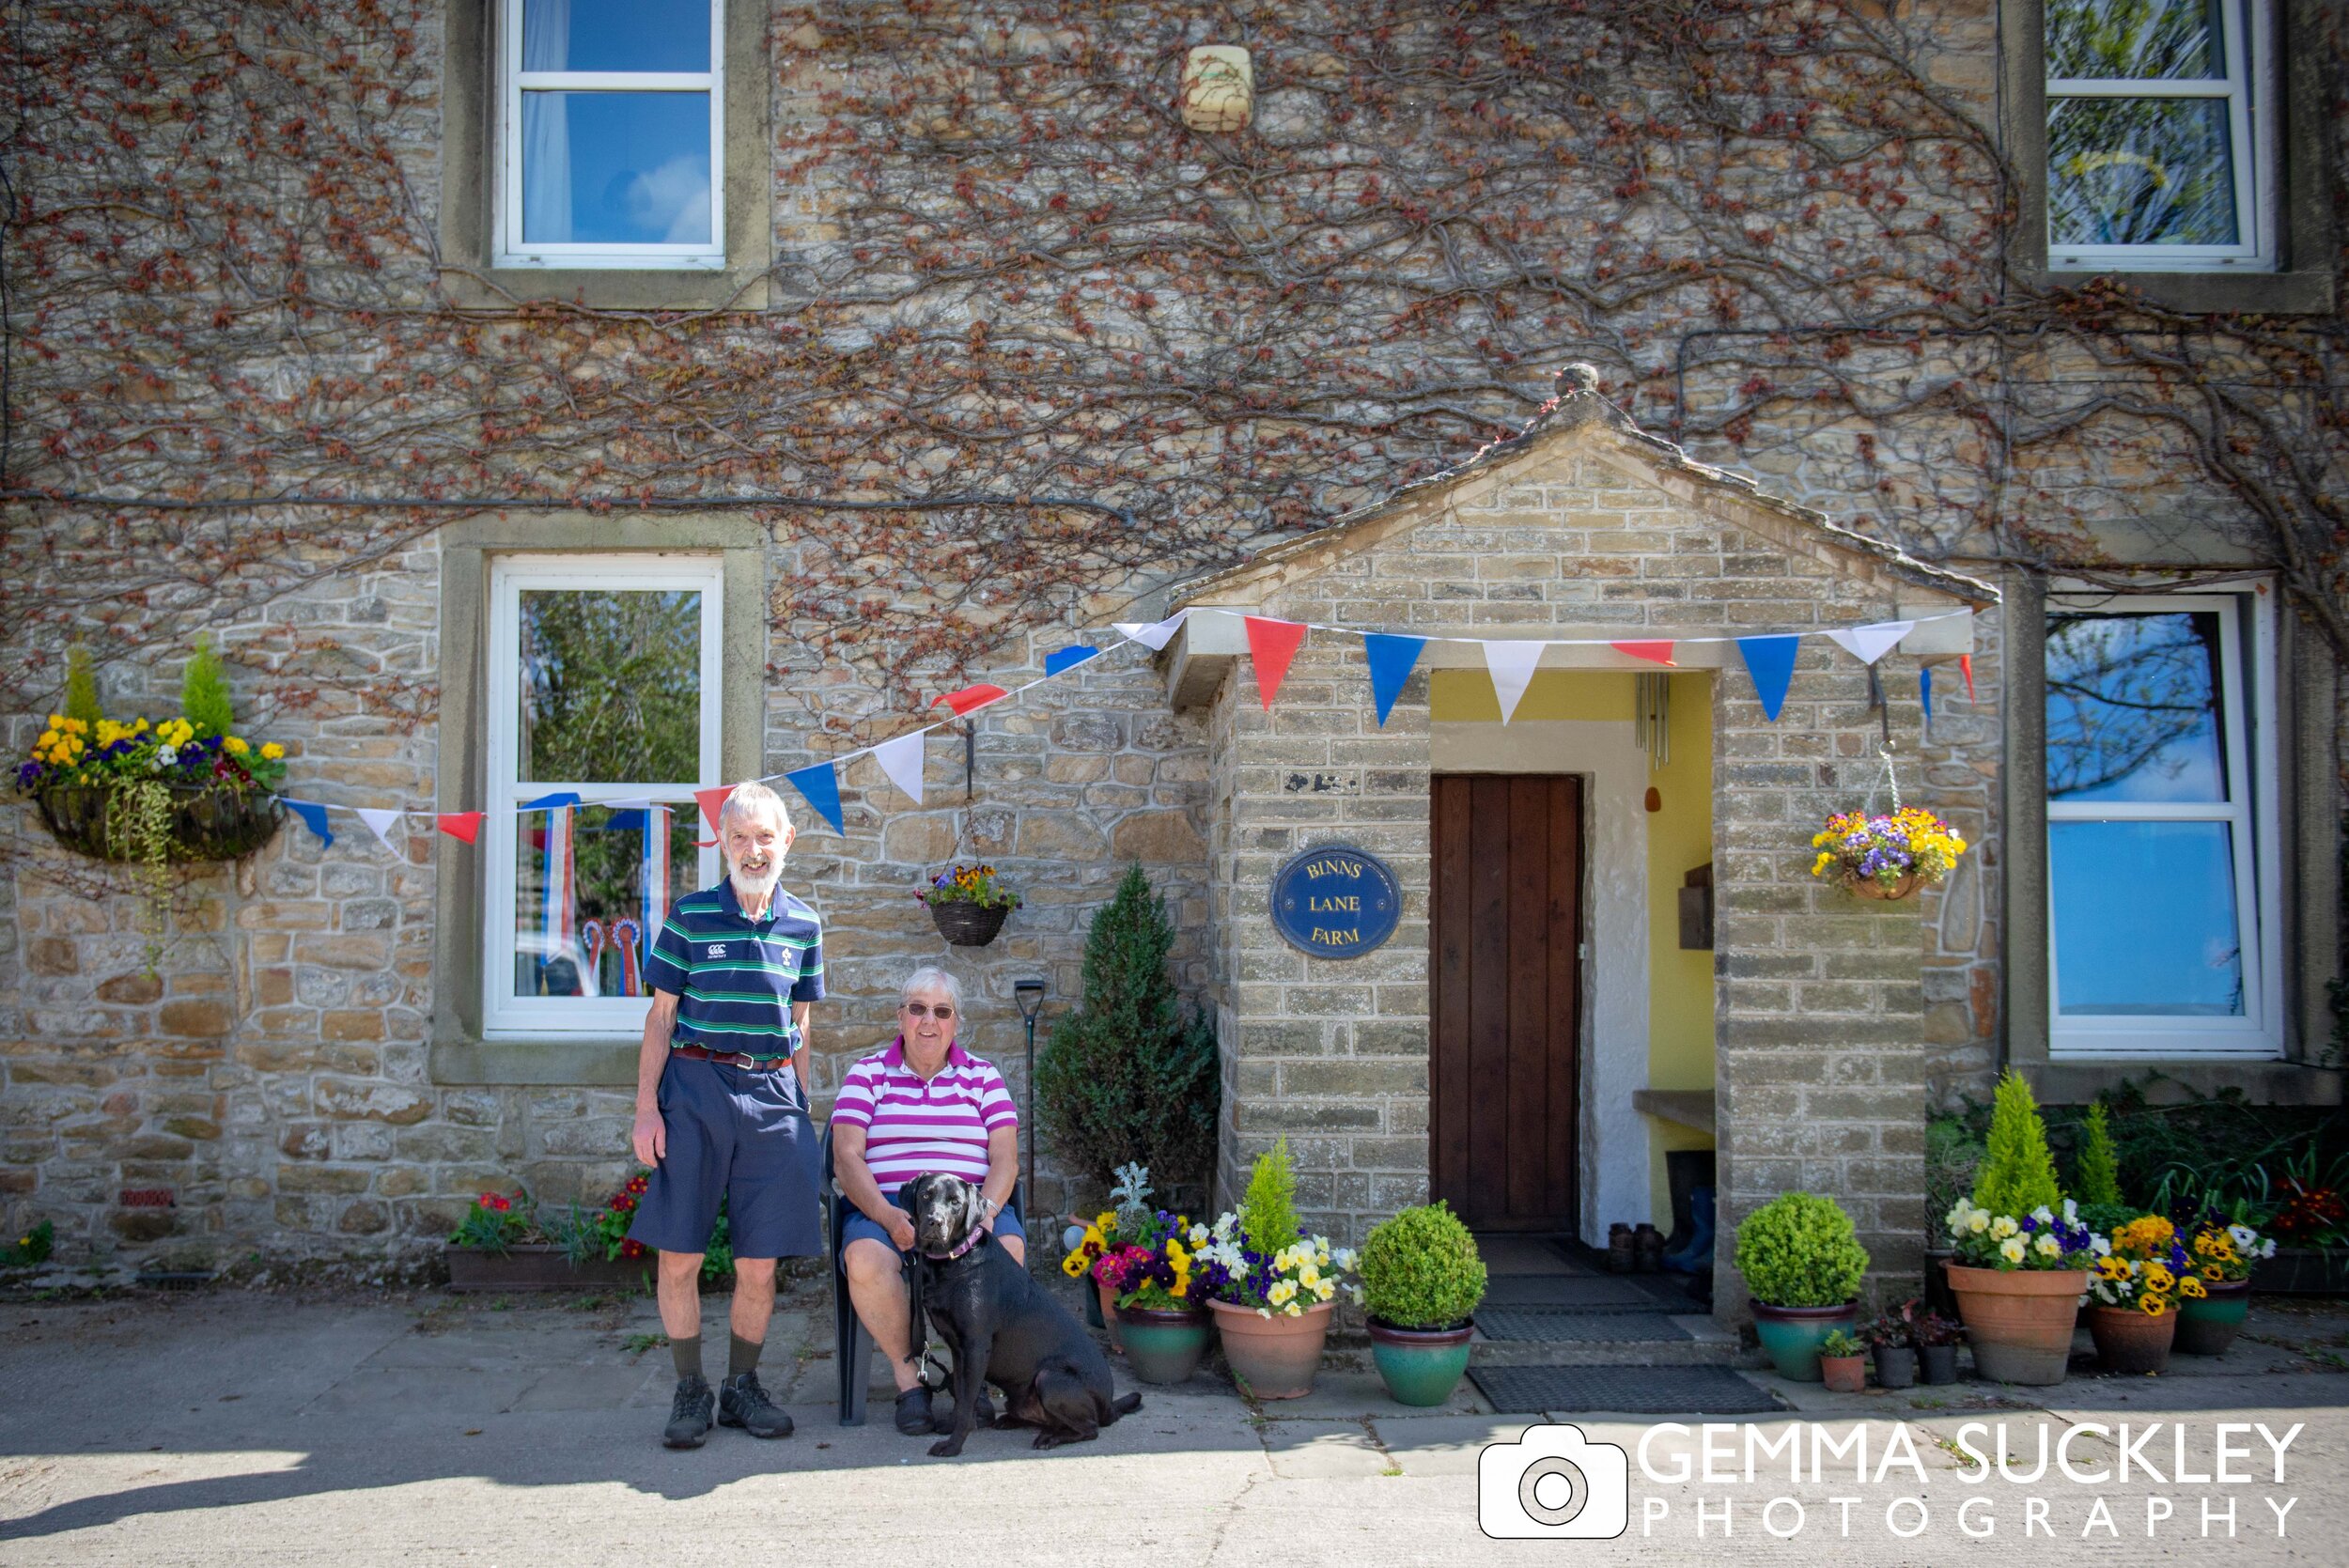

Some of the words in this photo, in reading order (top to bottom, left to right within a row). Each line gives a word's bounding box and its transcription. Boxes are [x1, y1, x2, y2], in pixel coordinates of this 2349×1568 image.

[1306, 859, 1362, 880] BINNS
[1310, 895, 1361, 912] LANE
[1311, 927, 1360, 946] FARM
